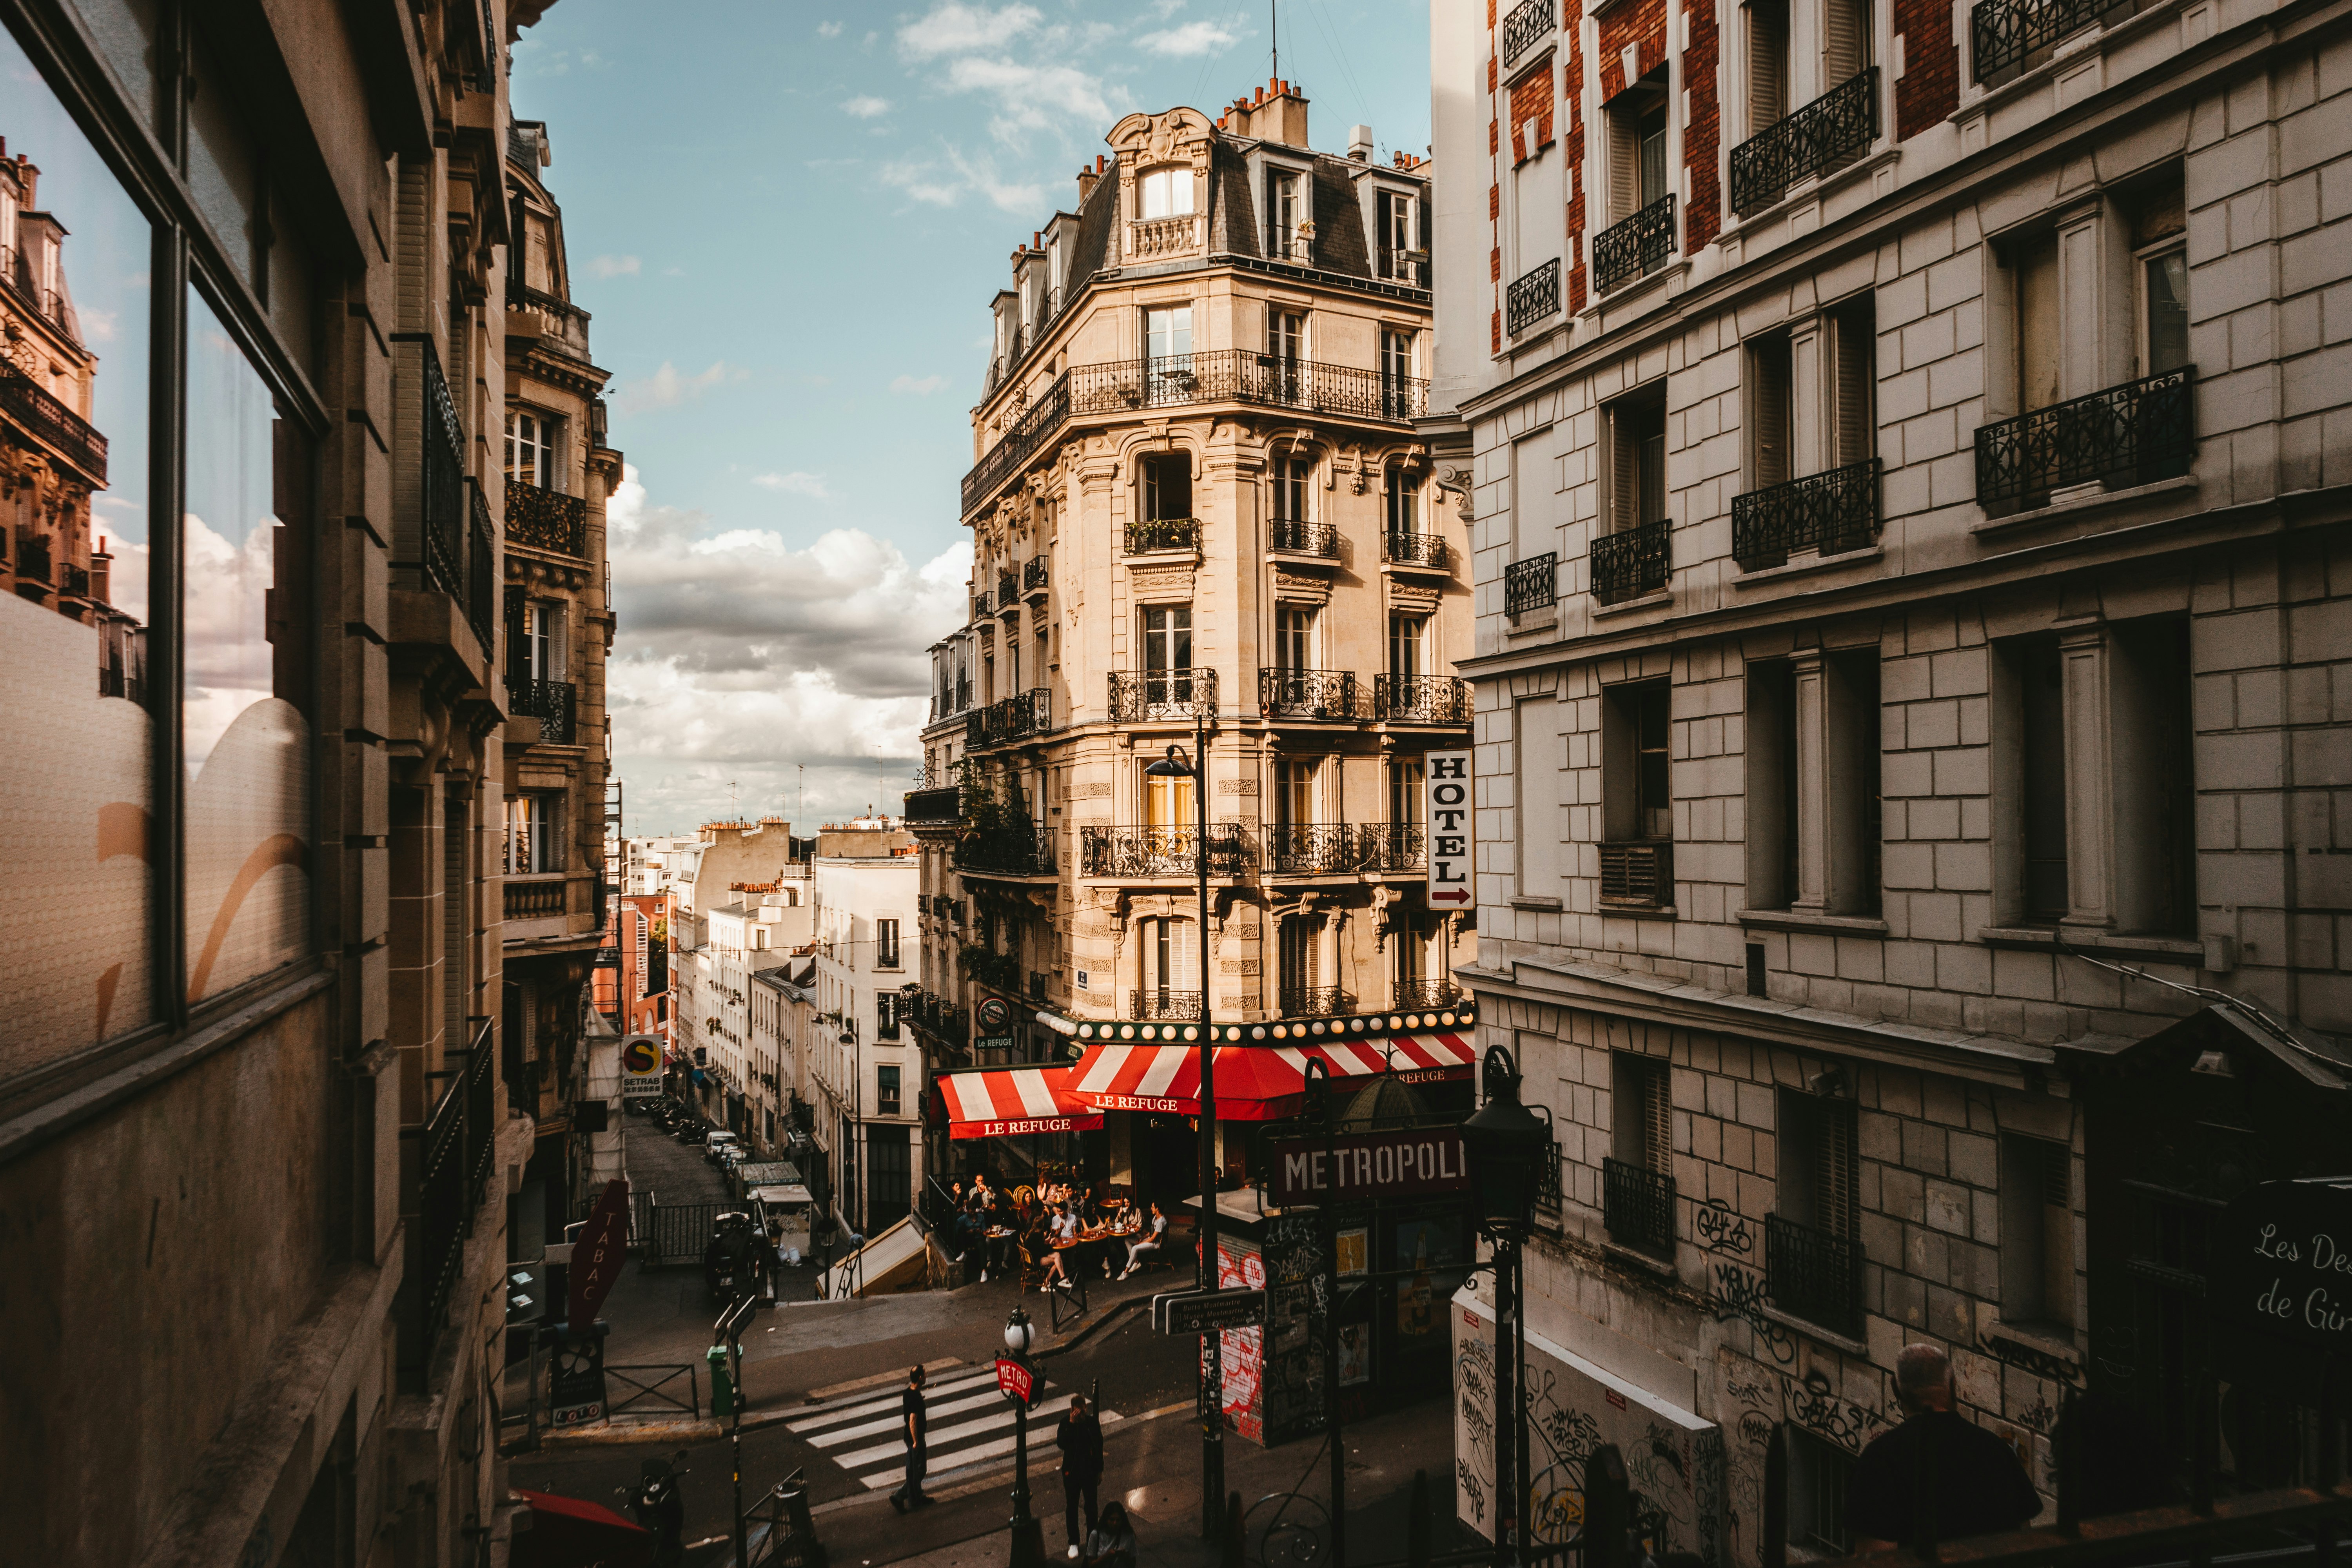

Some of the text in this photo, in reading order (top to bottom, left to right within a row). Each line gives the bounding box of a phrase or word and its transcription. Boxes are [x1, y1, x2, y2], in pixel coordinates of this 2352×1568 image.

[1431, 758, 1466, 882] HOTEL
[983, 1007, 1005, 1021] Heineken
[987, 1038, 1012, 1047] REFUGE
[624, 1078, 660, 1086] SETRAB
[1398, 1070, 1445, 1083] REFUGE
[1095, 1095, 1178, 1111] LE REFUGE
[984, 1119, 1071, 1135] LE REFUGE
[2254, 1223, 2303, 1261] Les
[583, 1212, 617, 1300] TABAC
[1203, 1299, 1240, 1309] Montmartre
[2257, 1278, 2294, 1318] de
[1183, 1307, 1244, 1321] Musée Montmartre
[1000, 1364, 1027, 1389] METRO
[556, 1405, 599, 1423] LOTO
